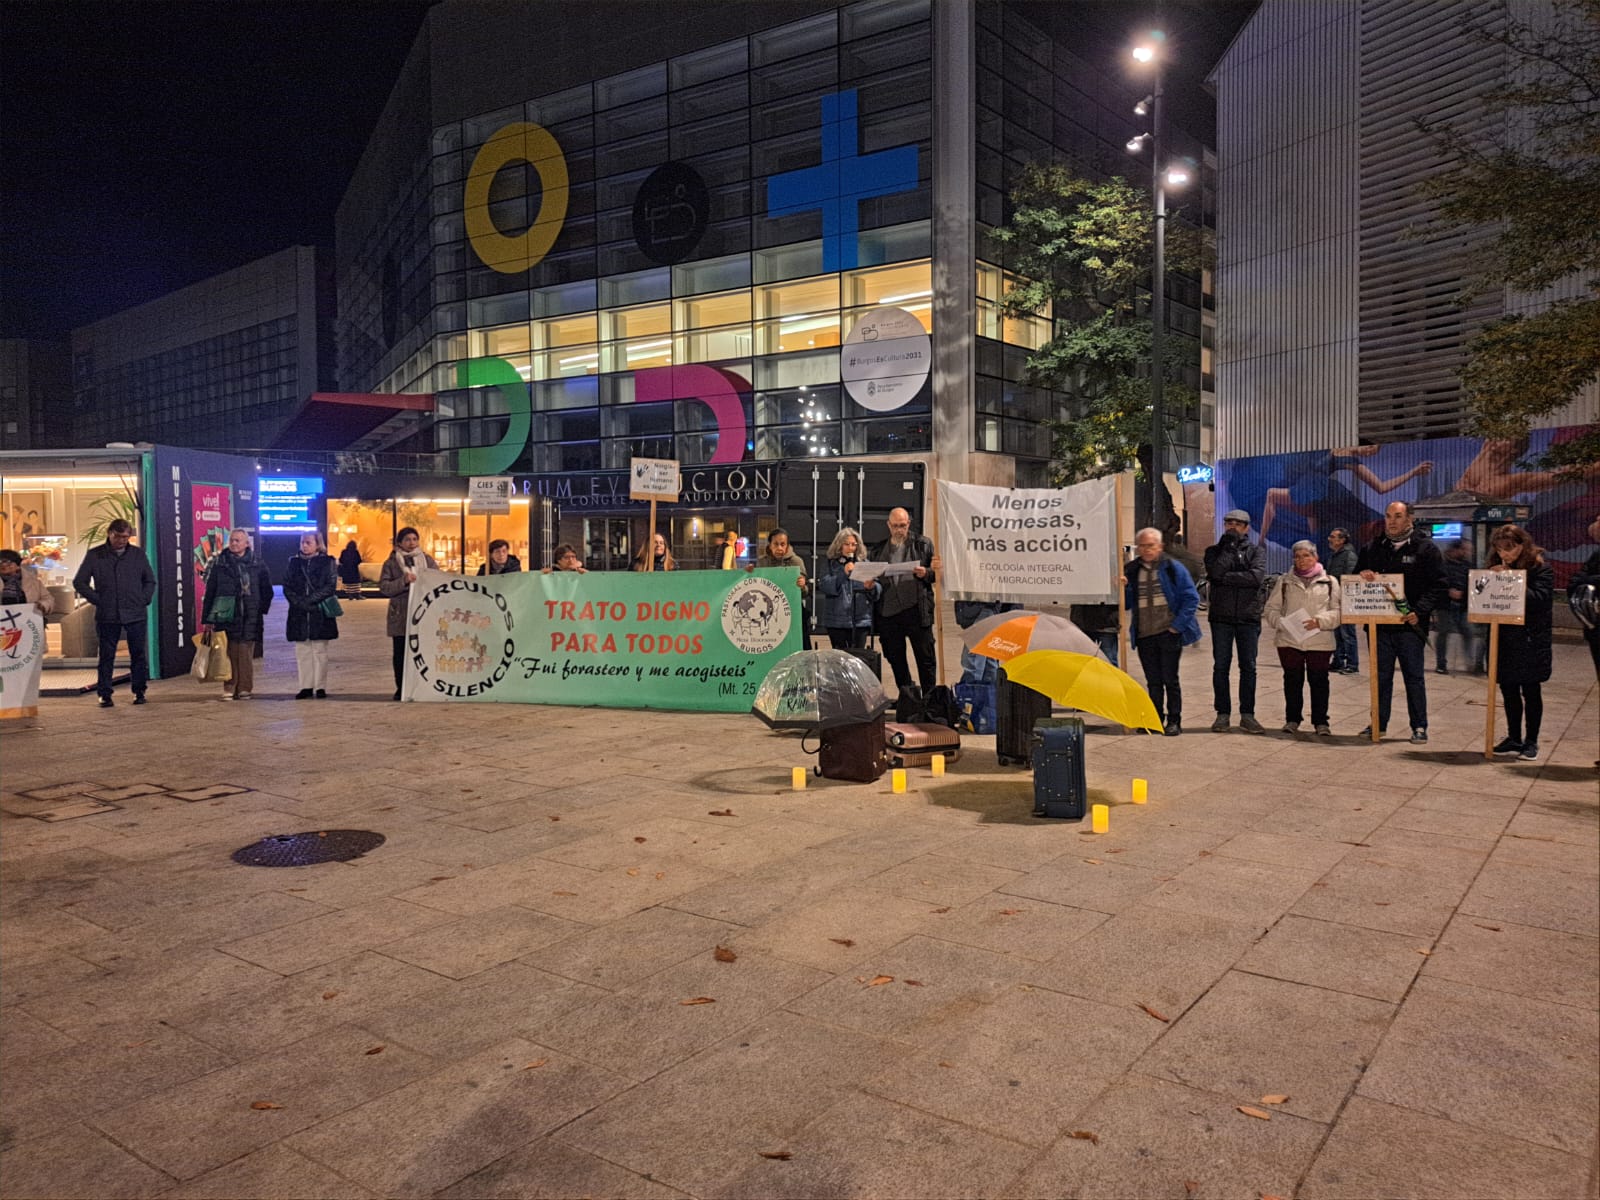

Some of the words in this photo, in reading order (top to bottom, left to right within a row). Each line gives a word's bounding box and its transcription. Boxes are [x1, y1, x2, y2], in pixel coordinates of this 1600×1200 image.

[992, 494, 1062, 510] Menos
[971, 514, 1081, 531] promesas,
[967, 534, 1007, 551] más
[1014, 534, 1087, 552] acción
[980, 562, 1025, 572] ECOLOGÍA
[1028, 563, 1074, 572] INTEGRAL
[744, 578, 758, 586] CON
[990, 575, 997, 584] Y
[999, 576, 1063, 584] MIGRACIONES
[411, 579, 515, 632] CIRCULOS
[543, 600, 627, 622] TRATO
[636, 601, 711, 622] DIGNO
[550, 632, 617, 654] PARA
[626, 633, 704, 655] TODOS
[740, 643, 773, 654] BURGOS
[408, 634, 429, 682] DEL
[433, 638, 515, 697] SILENCIO
[562, 659, 630, 680] forastero
[635, 665, 643, 681] y
[649, 665, 669, 677] me
[718, 682, 739, 697] (Mt.
